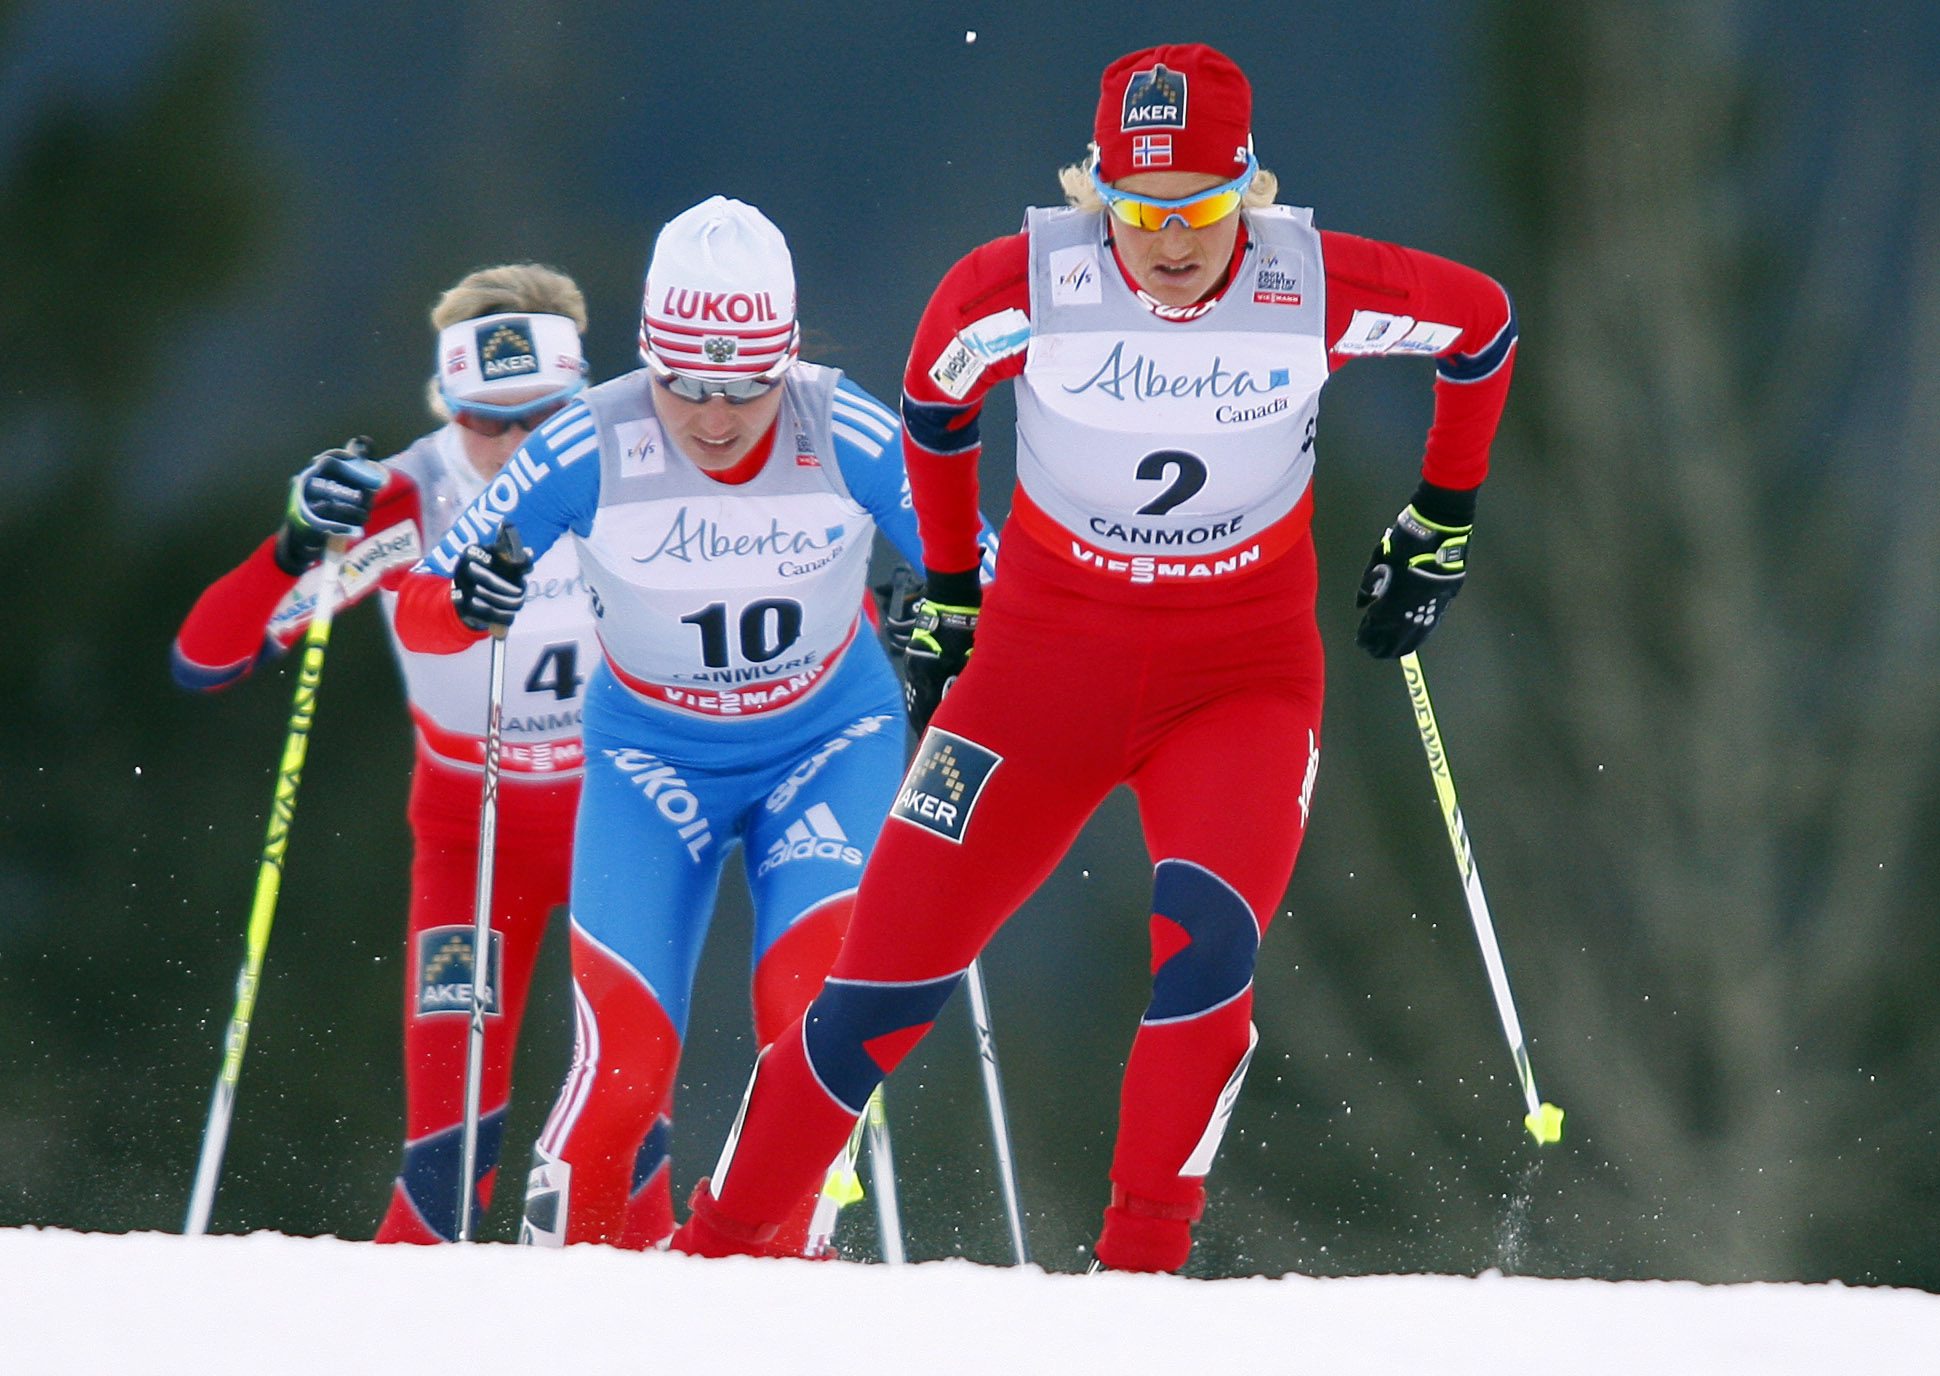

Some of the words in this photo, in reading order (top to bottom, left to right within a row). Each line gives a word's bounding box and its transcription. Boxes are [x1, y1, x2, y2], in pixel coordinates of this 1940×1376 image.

[1127, 104, 1179, 123] AKER
[663, 286, 777, 324] LUKOIL
[485, 354, 537, 376] AKER
[1061, 340, 1281, 401] Alberta
[1215, 398, 1289, 424] Canada
[1134, 449, 1209, 516] 2
[432, 448, 550, 573] LUKOIL
[1090, 514, 1244, 545] CANMORE
[352, 532, 414, 573] weber
[631, 506, 830, 564] Alberta
[680, 598, 803, 668] 10
[525, 640, 585, 701] 4
[898, 787, 958, 828] AKER
